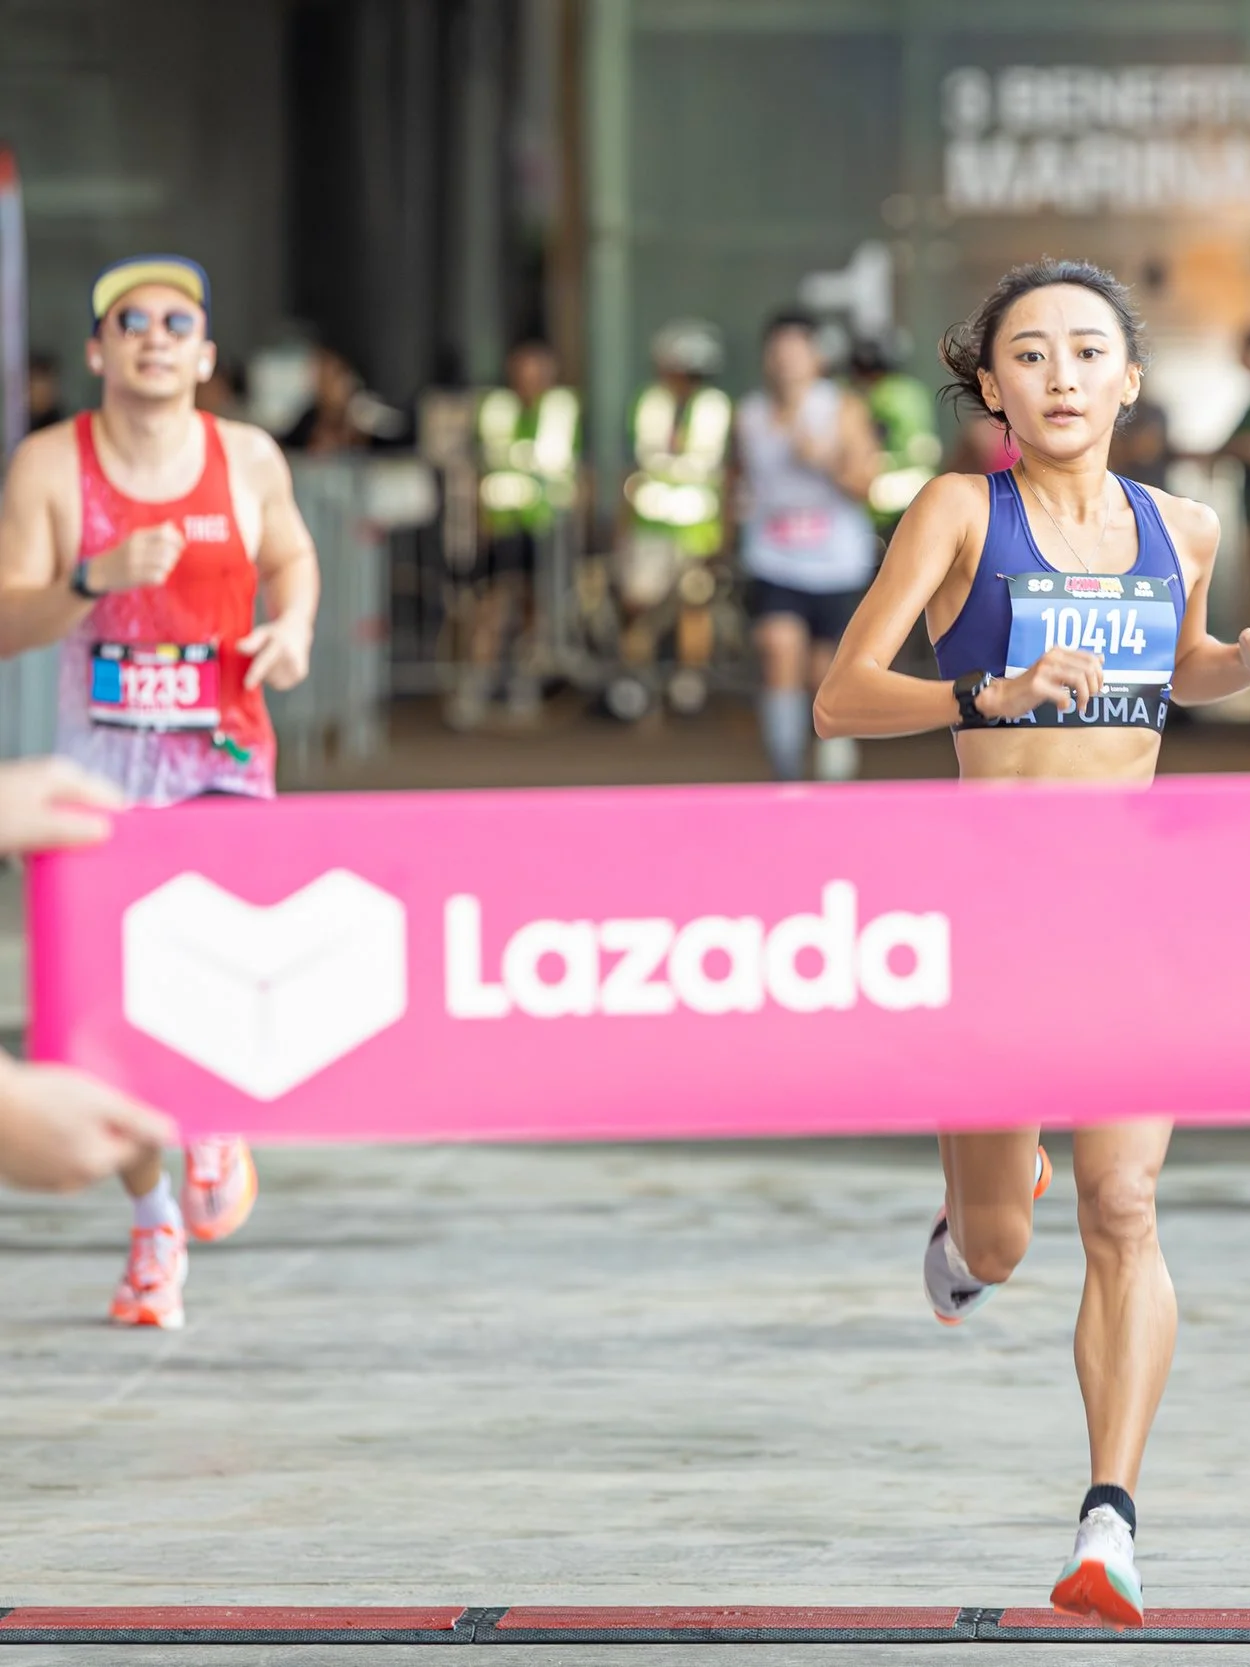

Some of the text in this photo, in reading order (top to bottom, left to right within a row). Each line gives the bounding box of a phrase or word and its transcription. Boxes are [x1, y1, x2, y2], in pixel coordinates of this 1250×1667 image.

[1041, 607, 1147, 655] 10414
[122, 664, 201, 706] 1233
[1057, 697, 1150, 724] PUMA
[444, 879, 951, 1019] Lazada
